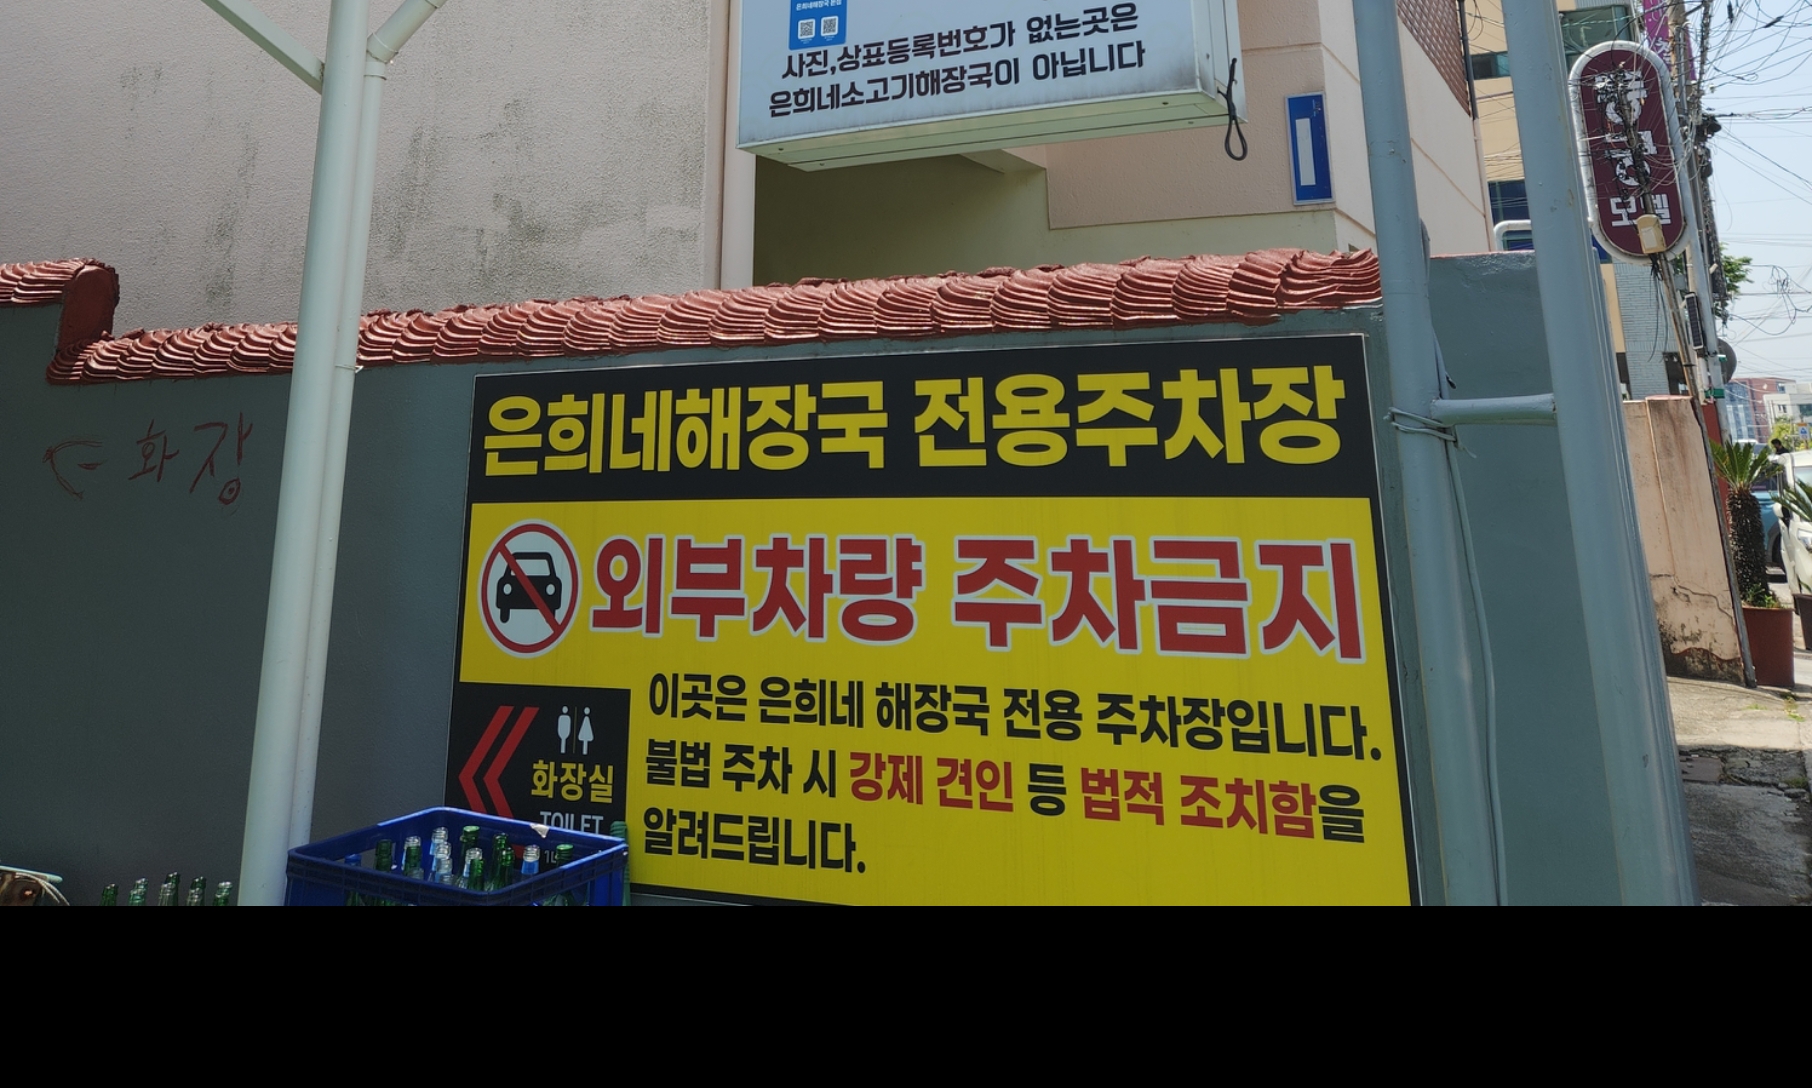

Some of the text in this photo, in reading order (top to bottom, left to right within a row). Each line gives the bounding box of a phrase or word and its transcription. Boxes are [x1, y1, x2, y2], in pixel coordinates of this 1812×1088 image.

[768, 40, 1146, 118] 은희네소고기해장국이 아닙니다
[781, 2, 1139, 81] 사진,상표등록번호가 없는곳은
[484, 364, 1346, 477] 은희네해장국 전용주차장
[591, 535, 1364, 661] 외부차량 주차금지
[649, 673, 1383, 761] 이곳은 은희네 해장국 전용 주차장입니다.
[531, 759, 616, 804] 화장실
[645, 738, 1366, 844] 불법 주차 시 강제 견인 등 법적 조치함을
[643, 806, 867, 874] 알려드립니다.
